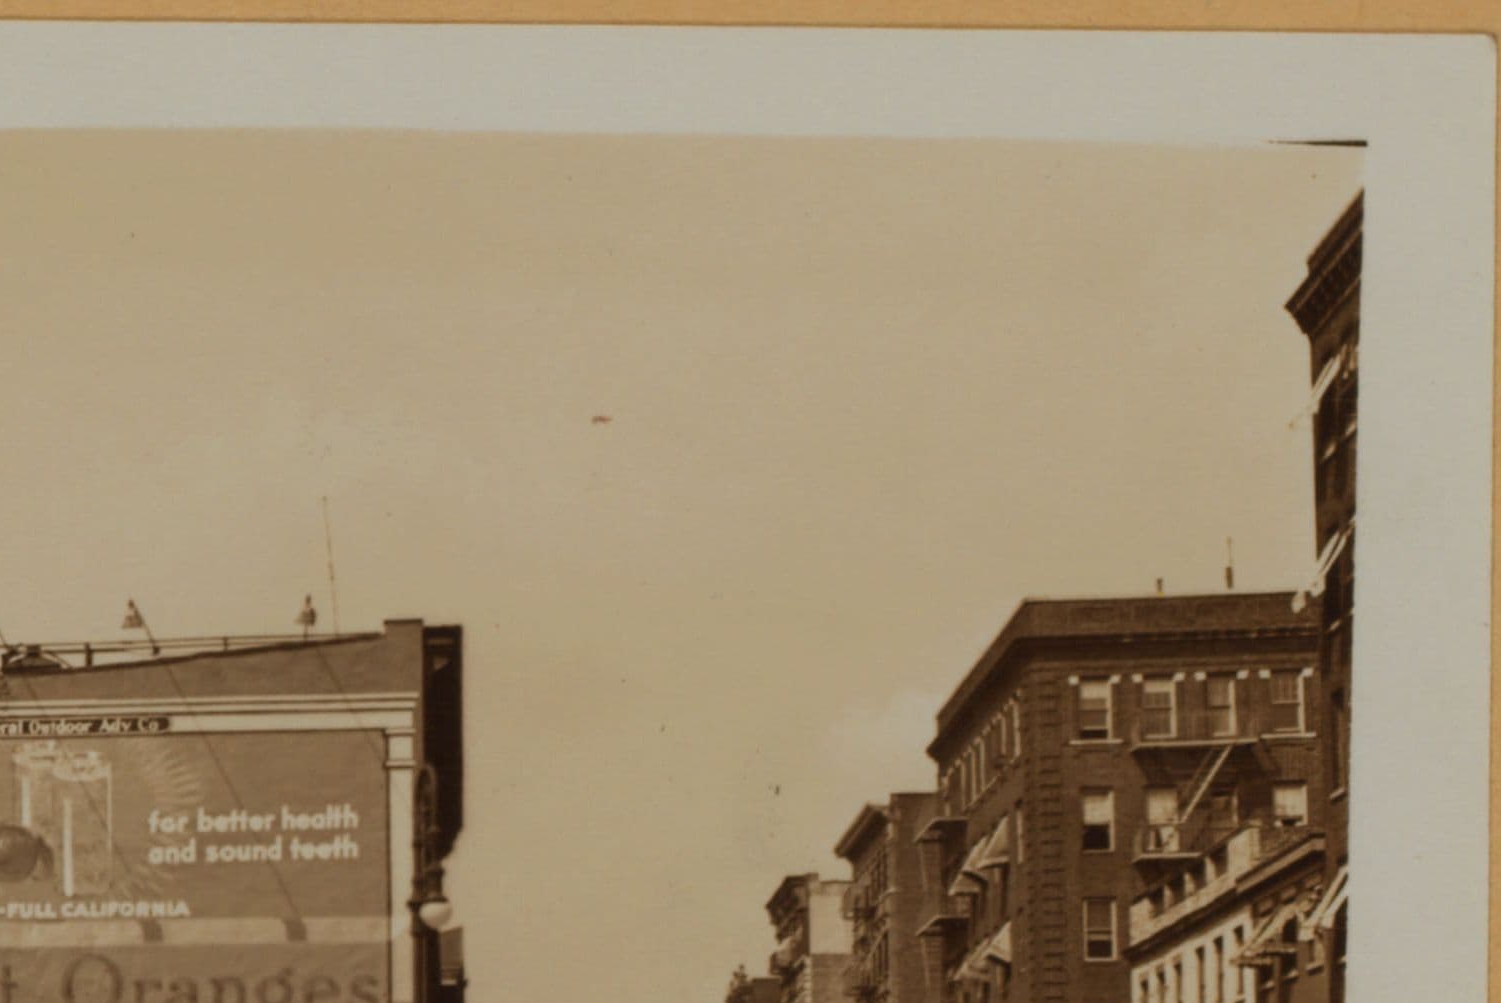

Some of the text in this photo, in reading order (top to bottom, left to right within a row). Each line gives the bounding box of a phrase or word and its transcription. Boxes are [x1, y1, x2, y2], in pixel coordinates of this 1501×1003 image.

[29, 719, 91, 735] Outdoor
[99, 718, 131, 732] Adv
[147, 804, 359, 834] for better health
[147, 833, 359, 865] and sound teeth
[61, 899, 190, 919] CALIFORNIA
